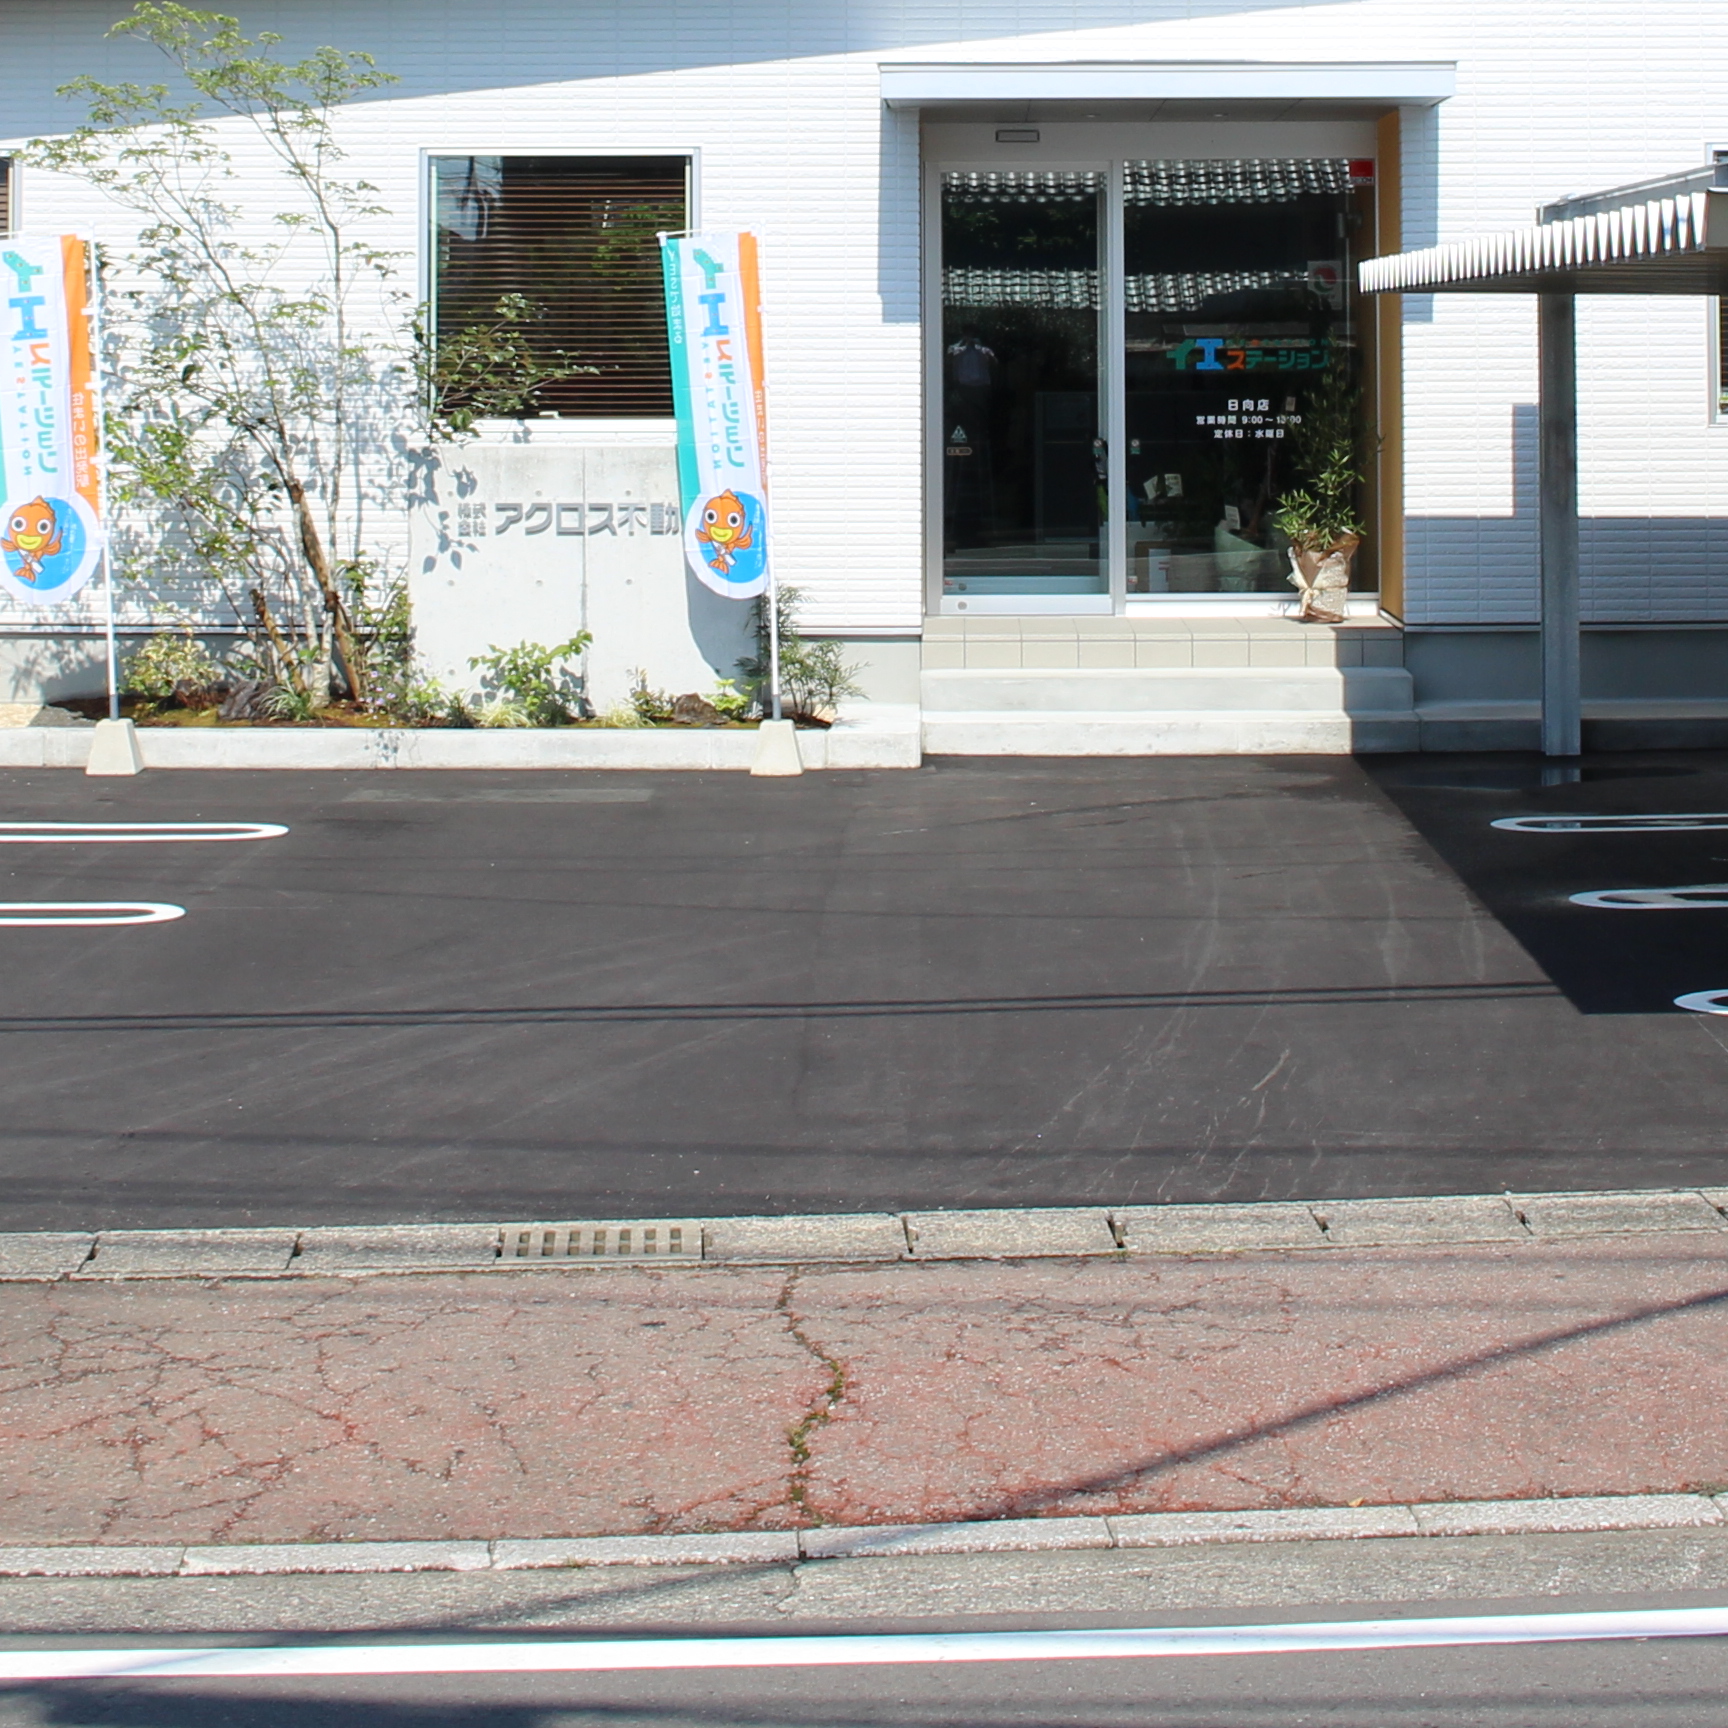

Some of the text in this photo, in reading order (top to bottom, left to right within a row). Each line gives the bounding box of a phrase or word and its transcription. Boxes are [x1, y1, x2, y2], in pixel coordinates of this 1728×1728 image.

[1228, 399, 1270, 411] 日向店
[1196, 415, 1237, 425] 営業時間
